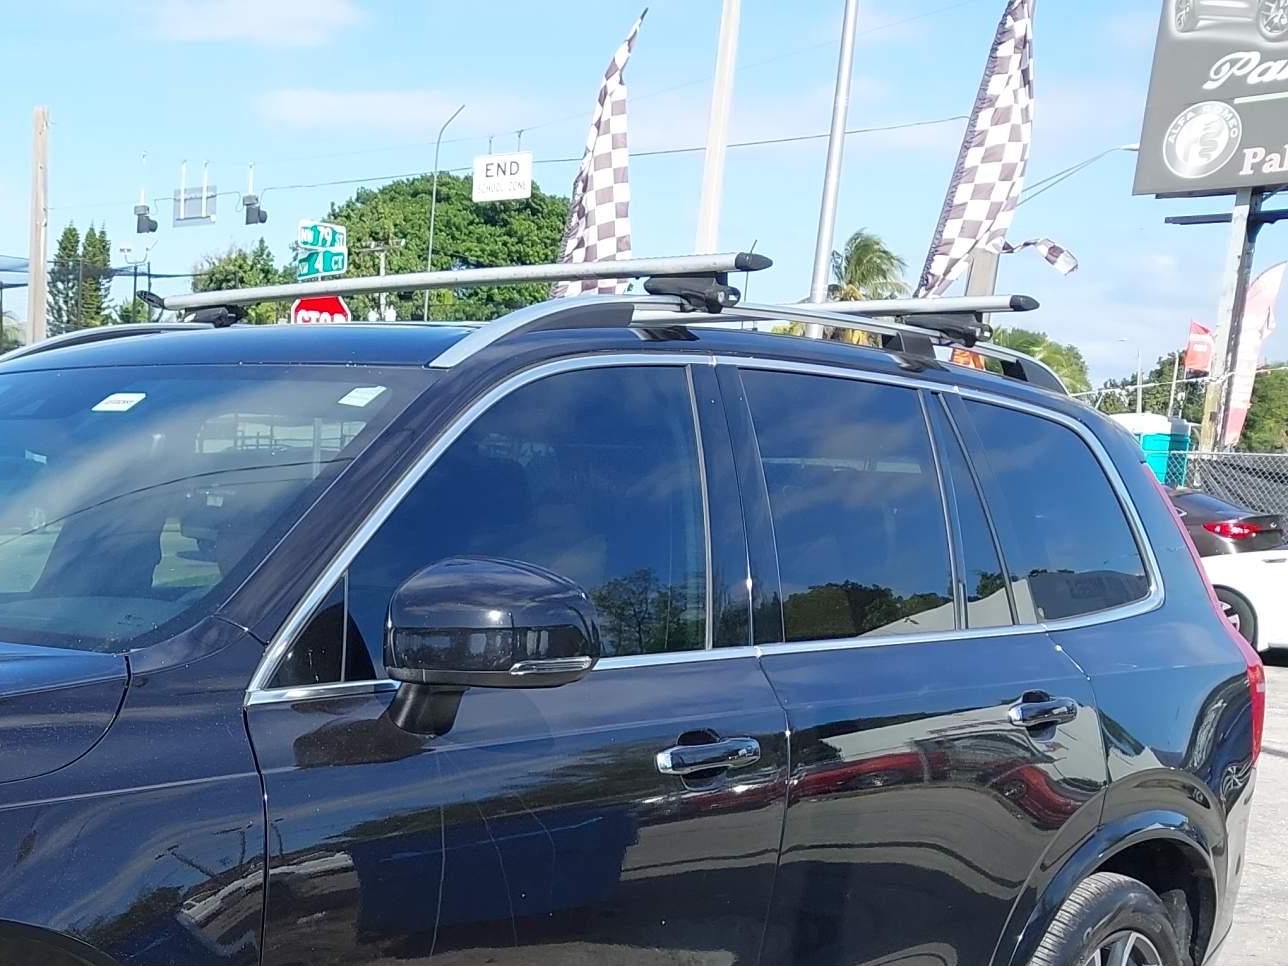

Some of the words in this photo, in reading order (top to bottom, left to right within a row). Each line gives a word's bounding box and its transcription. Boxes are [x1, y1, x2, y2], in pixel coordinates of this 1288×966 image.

[1202, 51, 1288, 90] Pa
[1168, 111, 1196, 143] ALFA
[485, 161, 520, 178] END
[316, 225, 333, 247] 79
